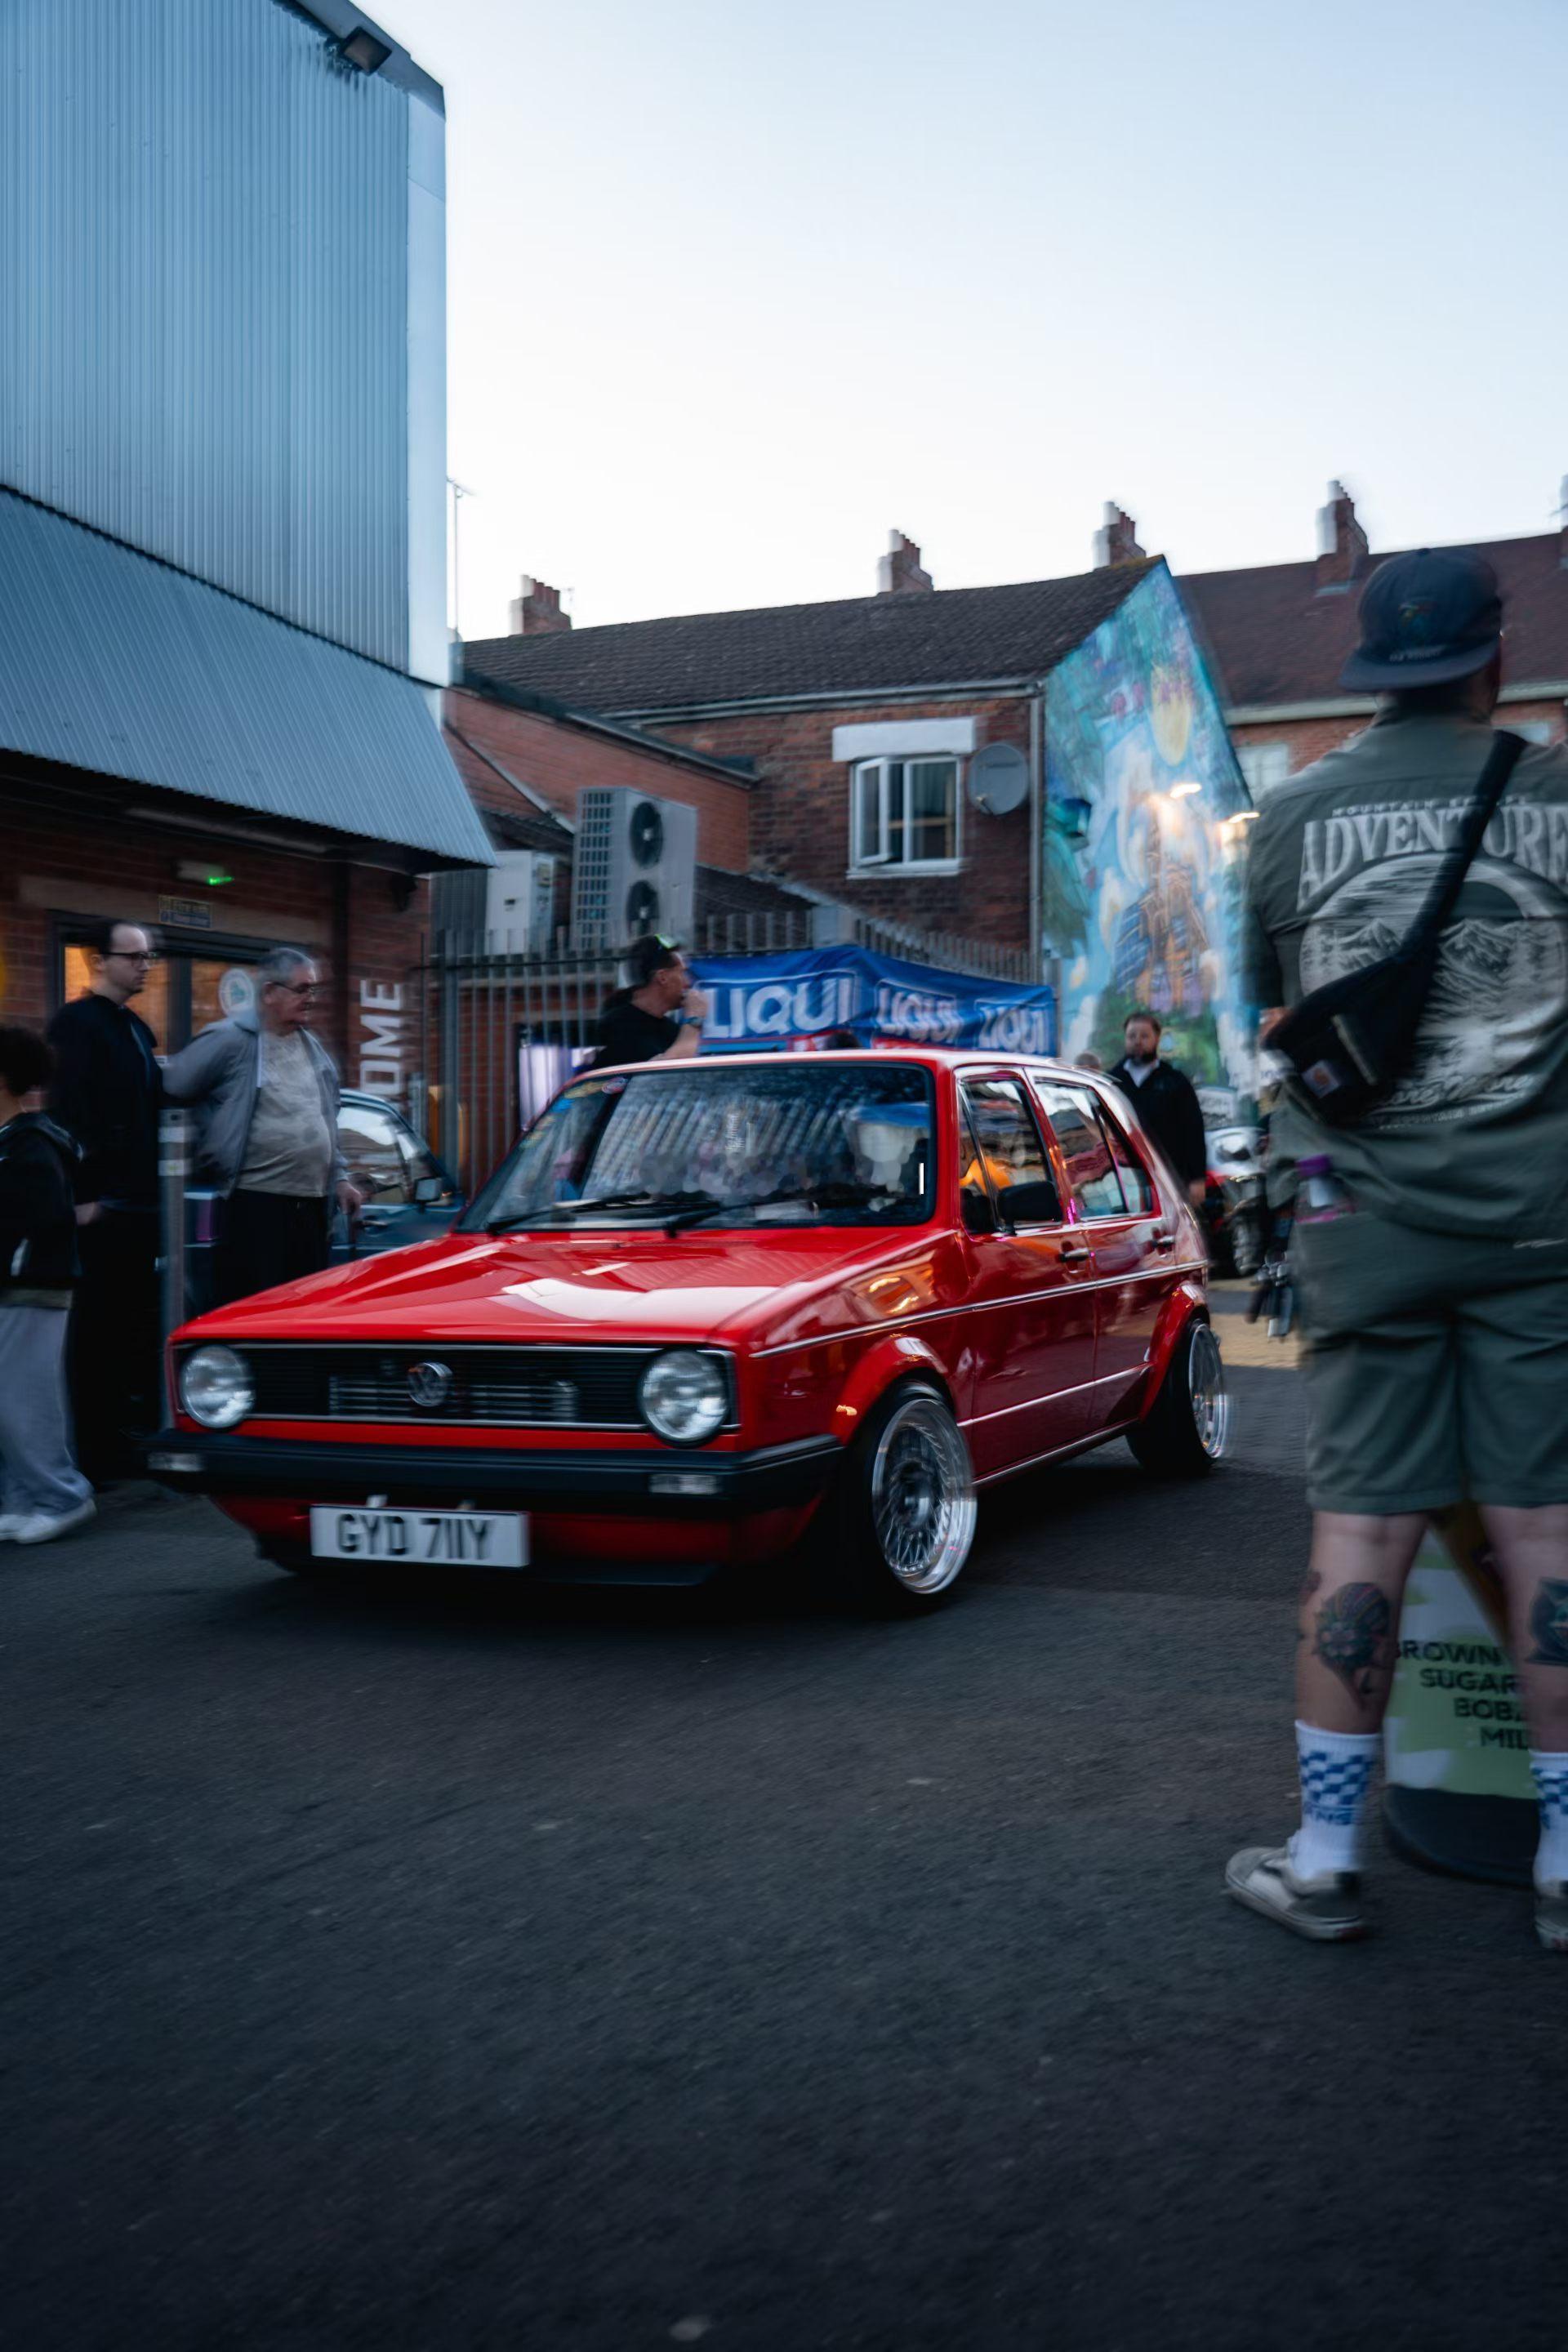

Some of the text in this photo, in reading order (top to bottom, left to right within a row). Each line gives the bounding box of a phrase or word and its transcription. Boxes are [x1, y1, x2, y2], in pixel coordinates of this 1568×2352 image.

[702, 978, 852, 1038] LIQUI
[875, 987, 962, 1042] LIQUI
[359, 980, 402, 1097] OME
[336, 1513, 408, 1556] GYD
[1401, 1640, 1503, 1666] ROWN
[1480, 1726, 1530, 1750] MIL
